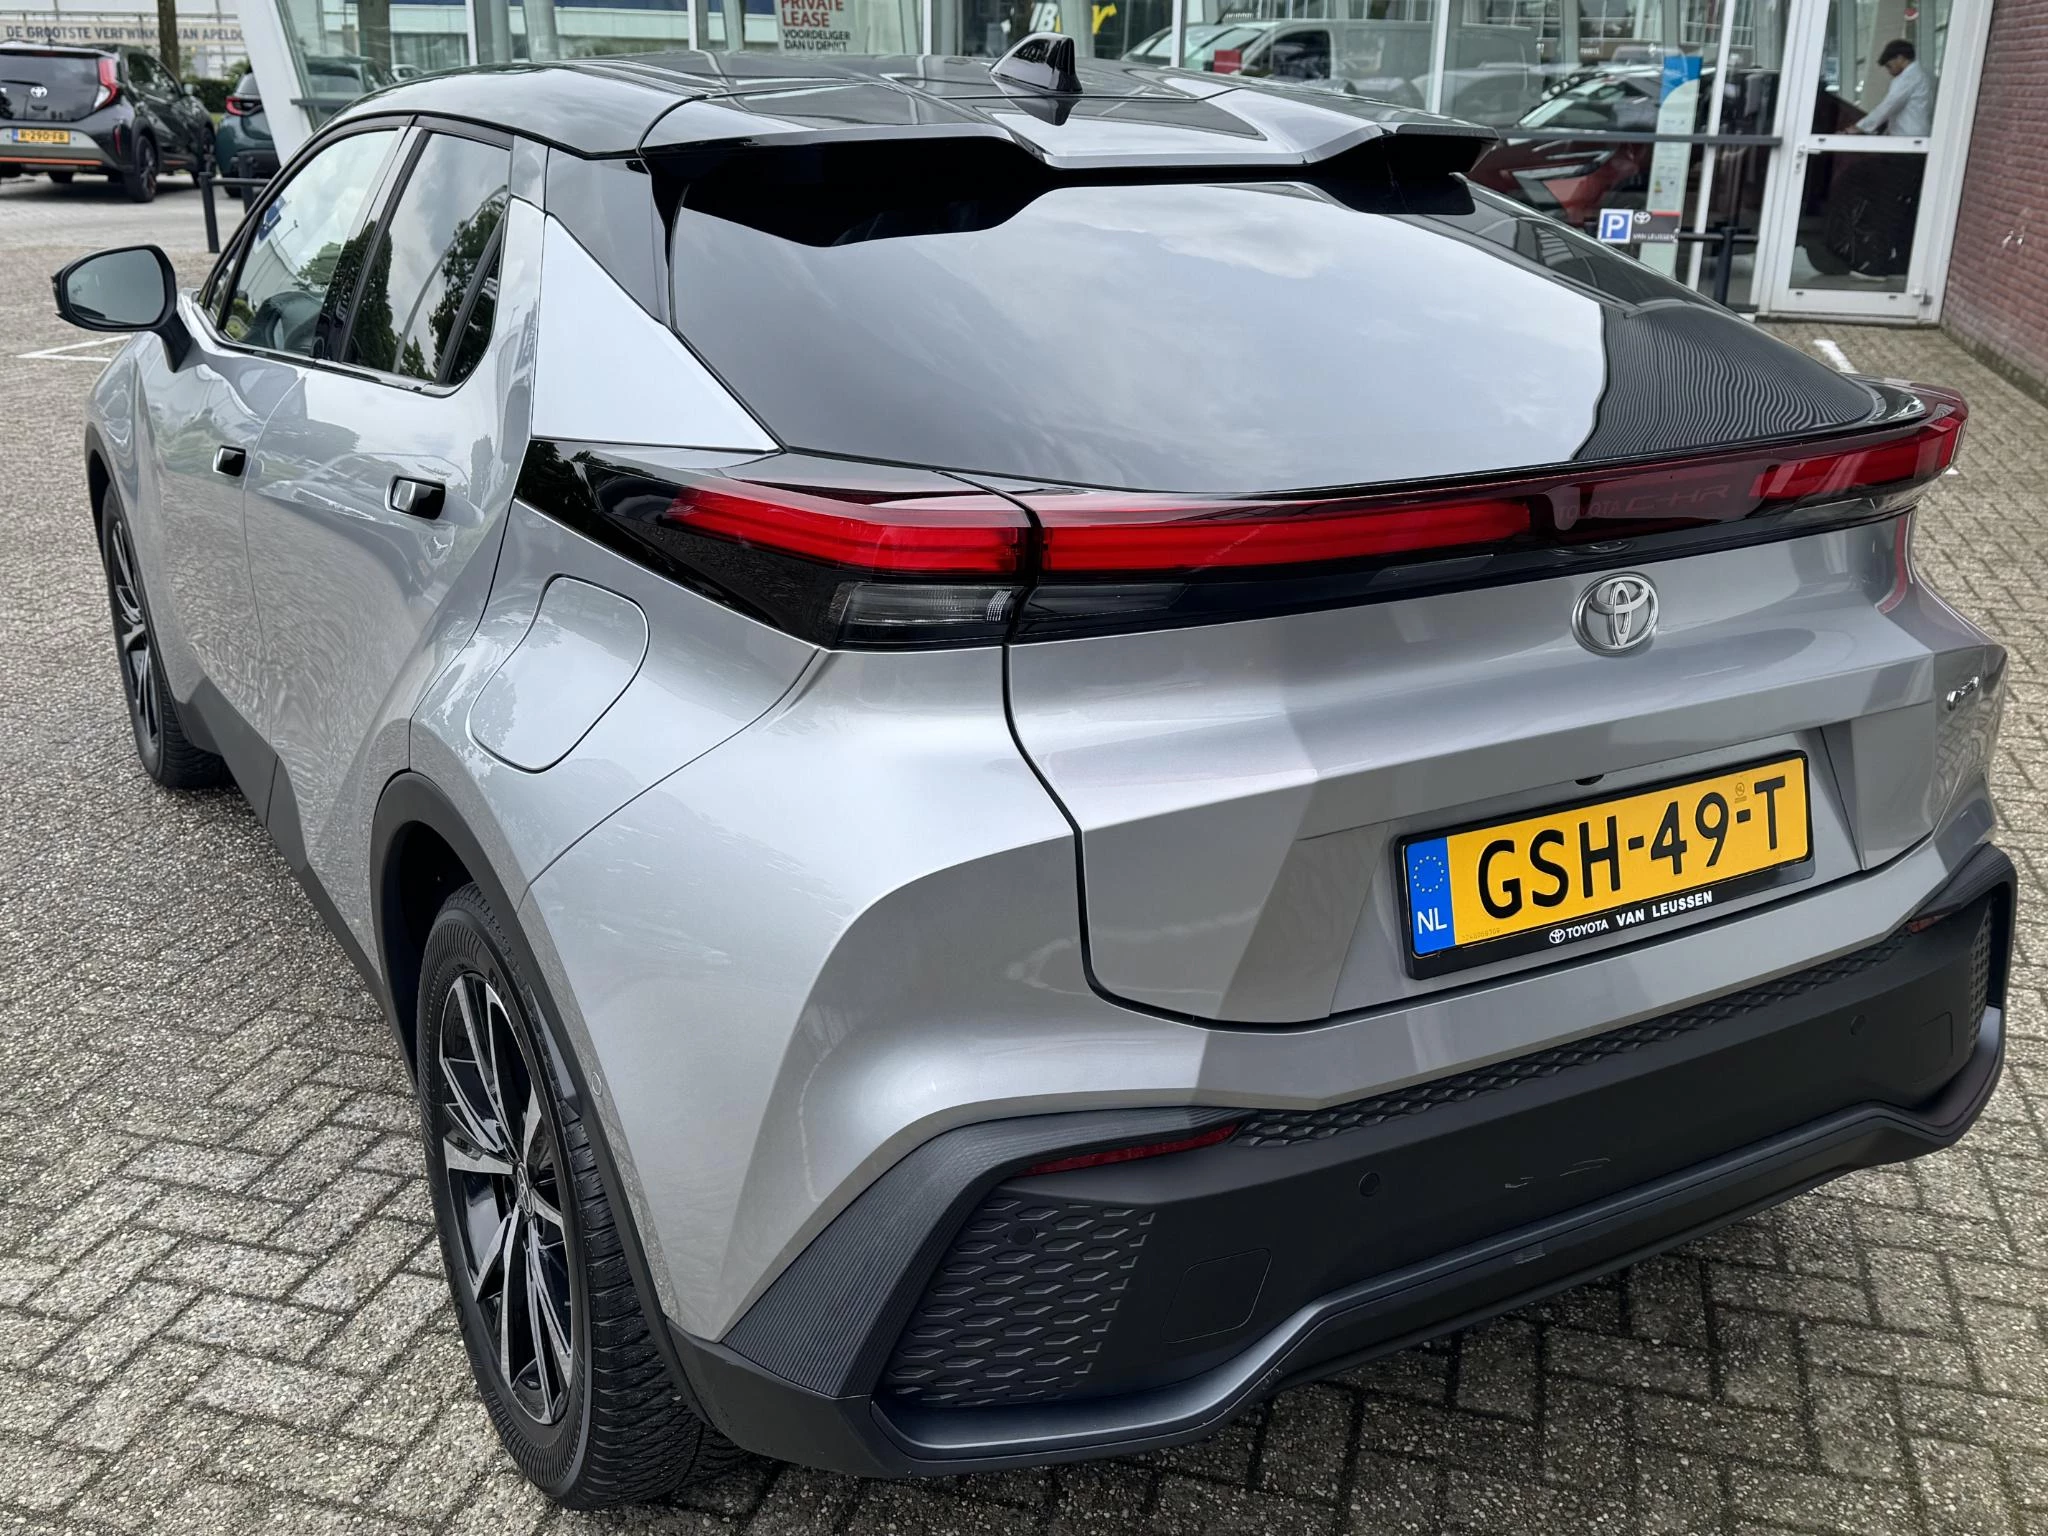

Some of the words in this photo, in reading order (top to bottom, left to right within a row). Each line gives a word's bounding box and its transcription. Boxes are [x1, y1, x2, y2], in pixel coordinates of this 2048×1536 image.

[781, 0, 844, 11] PRIVATE
[782, 11, 830, 27] LEASE
[6, 25, 23, 38] DE
[26, 26, 91, 39] GROOTSTE
[782, 29, 851, 41] VOORDELIGER
[784, 40, 806, 50] DAN
[807, 41, 814, 50] U
[1606, 214, 1625, 238] P
[1478, 775, 1786, 920] GSH-49-T
[1417, 909, 1448, 935] NL
[1566, 919, 1610, 939] TOYOTA
[1616, 908, 1645, 927] VAN
[1652, 890, 1713, 918] LEUSSEN
